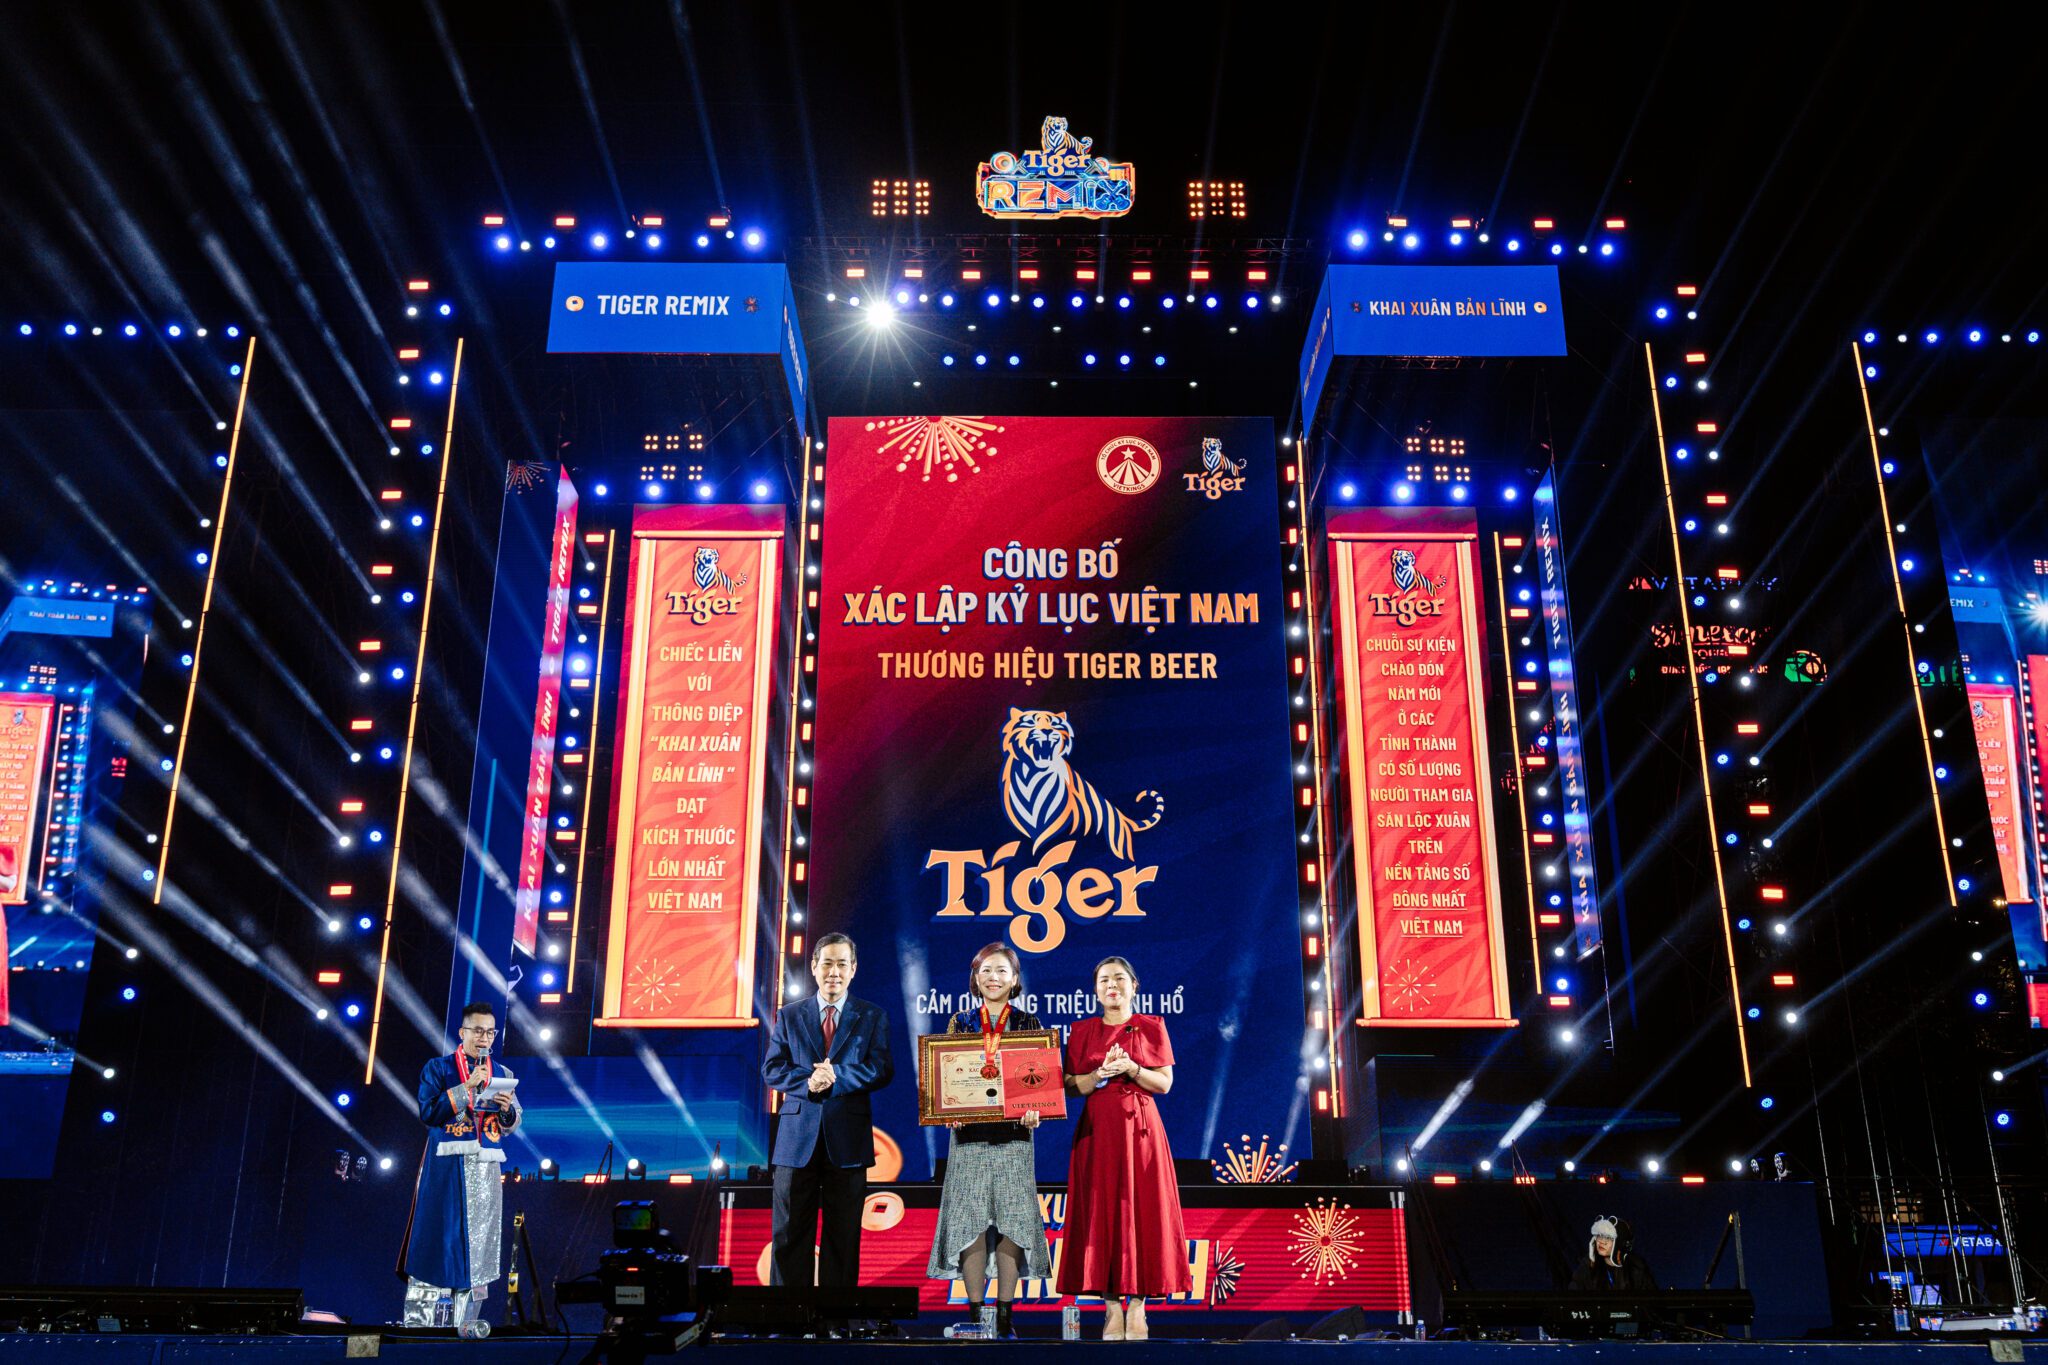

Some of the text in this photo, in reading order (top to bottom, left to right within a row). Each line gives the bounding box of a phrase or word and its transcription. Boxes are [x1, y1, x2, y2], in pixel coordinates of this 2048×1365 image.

[1024, 149, 1091, 176] Tiger
[986, 180, 1132, 211] REMIX
[597, 295, 730, 316] TIGER REMIX
[1369, 297, 1526, 316] KHAI XUÂN BẢN LĨNH
[1183, 471, 1246, 500] Tiger
[983, 538, 1122, 579] CÔNG BỐ
[551, 514, 571, 644] TIGER REMIX
[1542, 516, 1561, 650] TIGER REMIX
[666, 590, 743, 625] Tiger
[843, 583, 1259, 634] XÁC LẬP KỶ LỤC VIỆT NAM
[1369, 591, 1445, 626] Tiger
[1950, 598, 1974, 608] EMIX
[660, 640, 742, 662] CHIẾC LIỄN
[1366, 633, 1455, 656] CHUỖI SỰ KIỆN
[877, 646, 1218, 686] THƯƠNG HIỆU TIGER BEER
[1382, 660, 1444, 676] CHÀO ĐÓN
[687, 672, 711, 691] VỚI
[1388, 684, 1441, 700] NĂM MỚI
[652, 702, 743, 726] THÔNG ĐIỆP
[1398, 708, 1435, 725] Ở CÁC
[698, 732, 741, 752] XUÂN
[1380, 734, 1456, 751] TỈNH THÀNH
[652, 761, 684, 782] BẢN
[1379, 758, 1461, 780] CÓ SỐ LƯỢNG
[1370, 784, 1474, 802] NGƯỜI THAM GIA
[676, 797, 706, 818] ĐẠT
[529, 797, 542, 859] XUÂN
[1377, 811, 1470, 831] SĂN LỘC XUÂN
[642, 824, 735, 844] KÍCH THƯỚC
[1408, 837, 1443, 854] TRÊN
[648, 855, 726, 876] LỚN NHẤT
[1385, 861, 1471, 880] NỀN TẢNG SỐ
[648, 889, 722, 914] VIỆT NAM
[925, 840, 1159, 953] Tiger
[1393, 888, 1466, 907] ĐÔNG NHẤT
[1401, 917, 1463, 938] VIỆT NAM
[916, 988, 952, 1014] CẢM
[1016, 994, 1038, 1014] NG
[1044, 989, 1097, 1019] TRIỆU
[1131, 994, 1153, 1014] NH
[1160, 985, 1184, 1014] HỔ
[445, 1122, 475, 1137] Tiger
